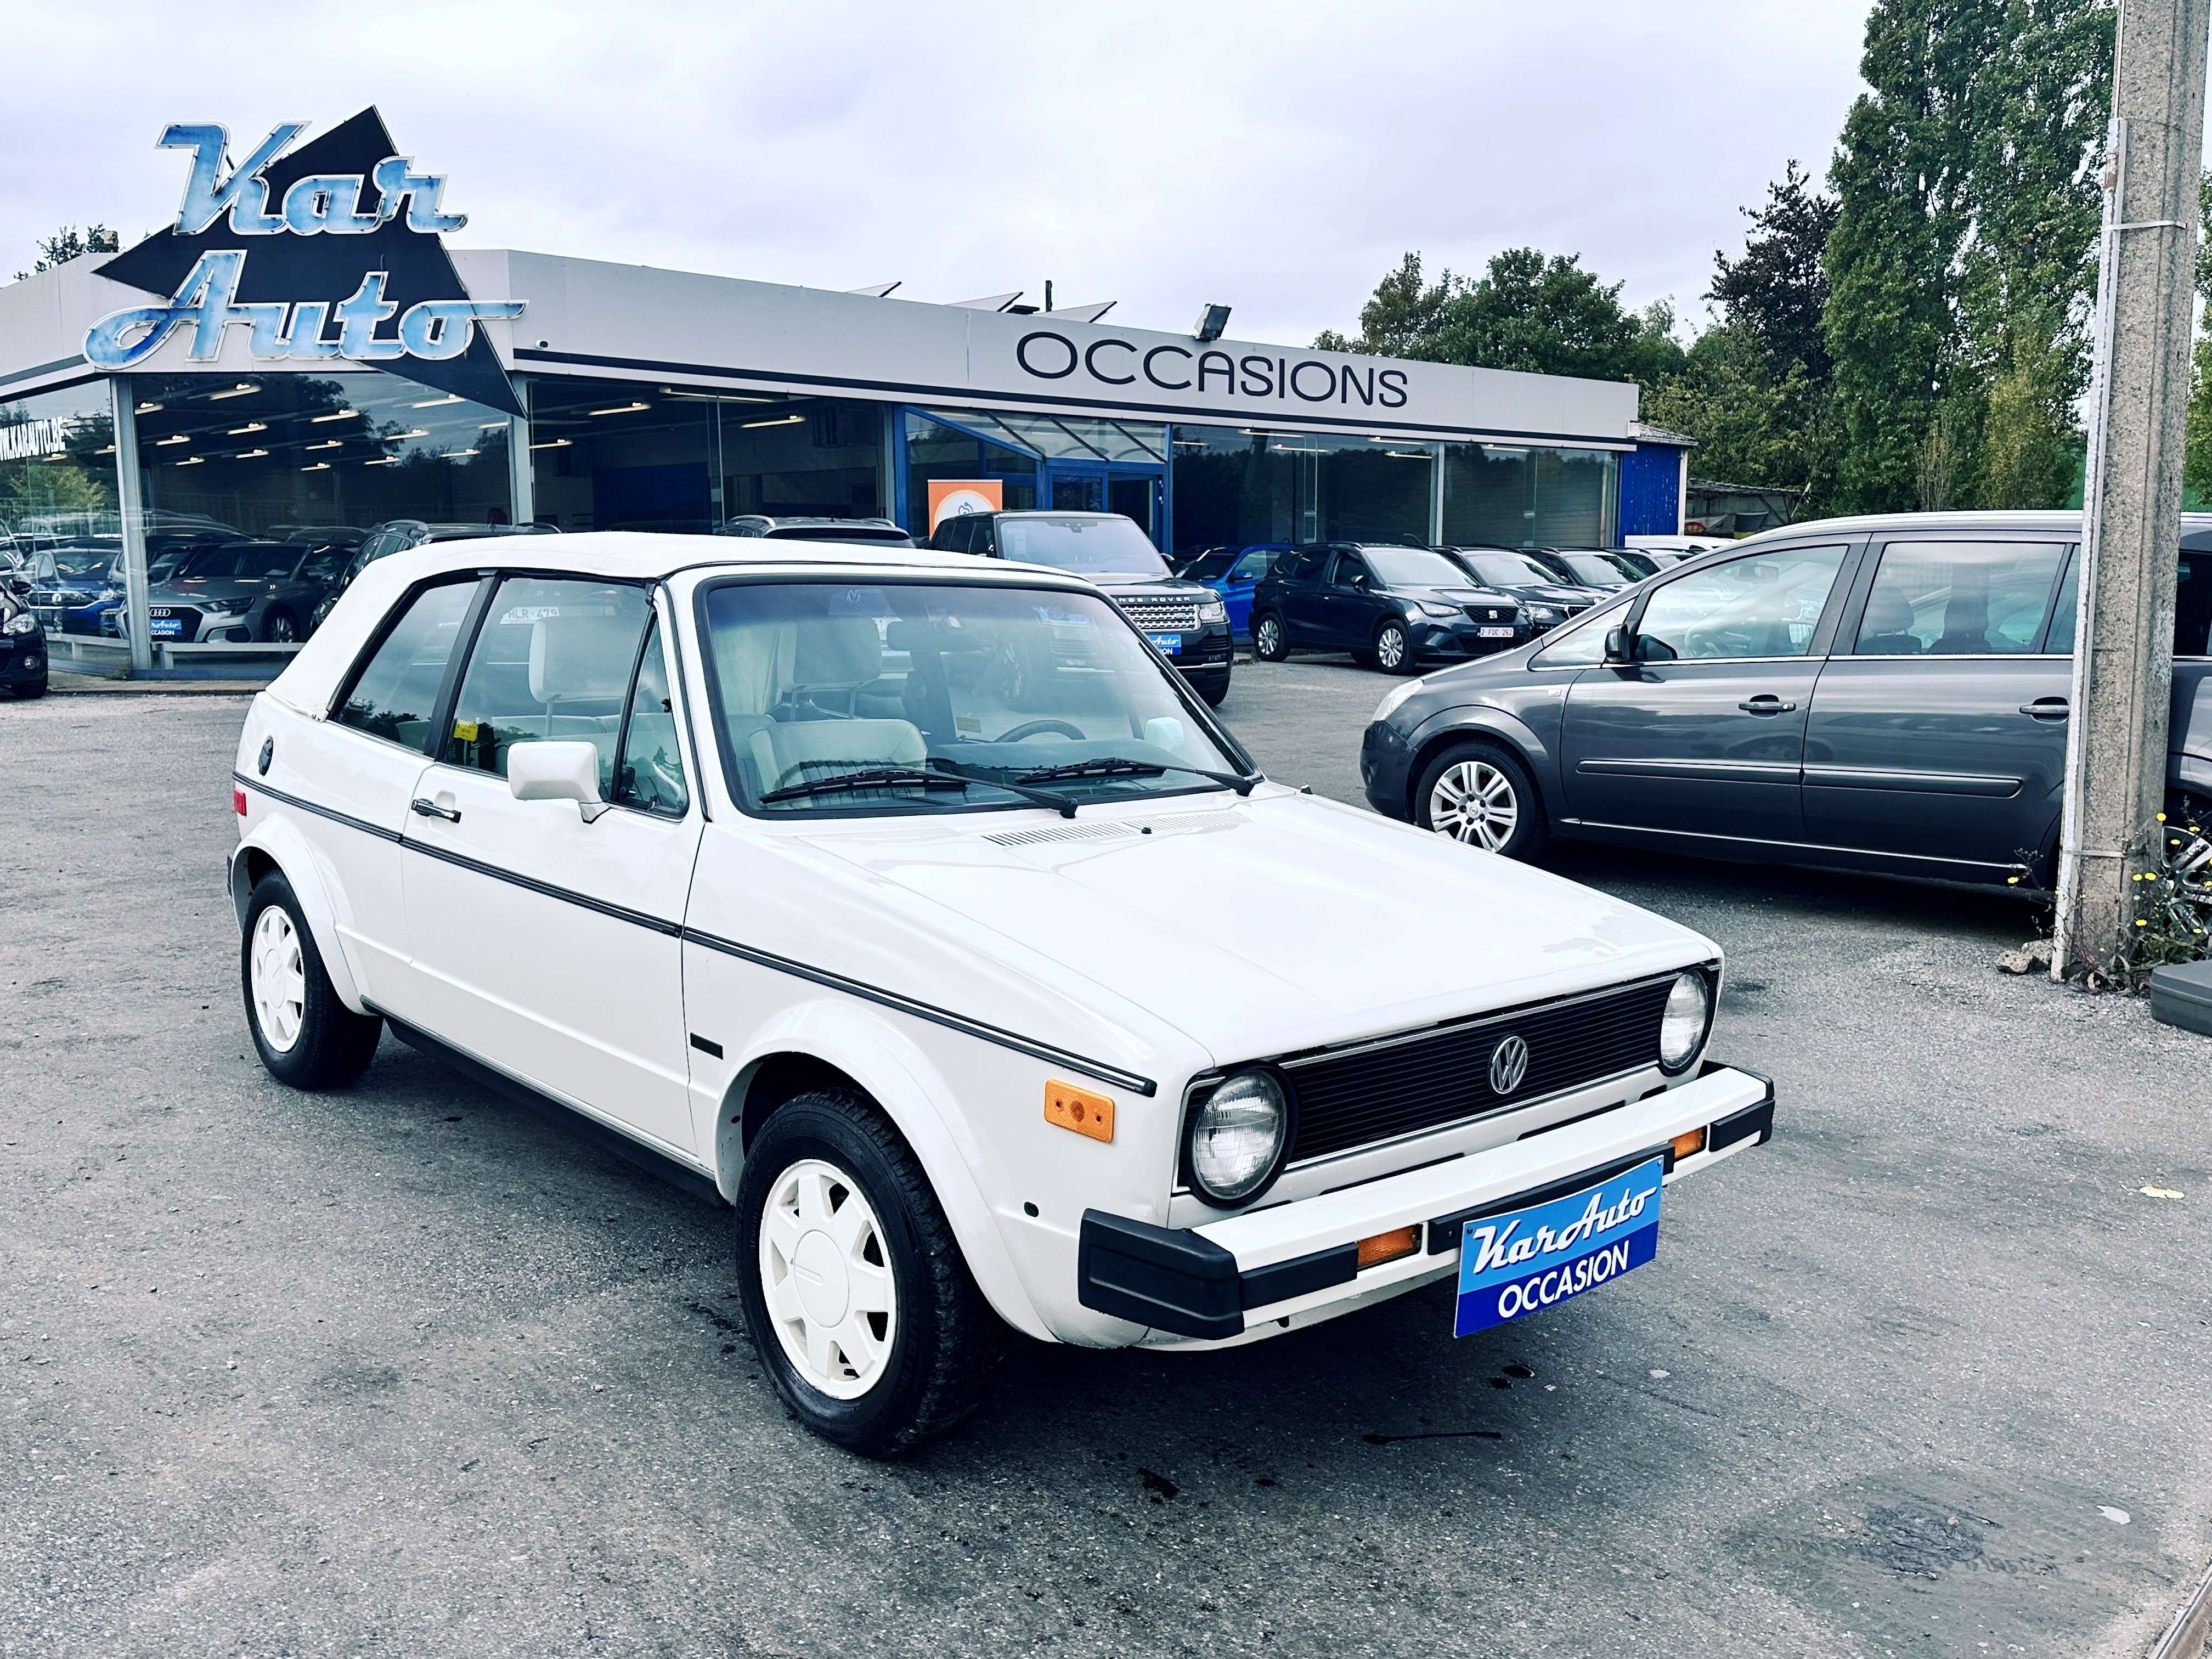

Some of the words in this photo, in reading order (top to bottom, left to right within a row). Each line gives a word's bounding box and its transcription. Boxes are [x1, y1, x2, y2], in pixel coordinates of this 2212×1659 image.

[154, 121, 468, 236] Kar
[81, 249, 529, 370] Auto
[1017, 331, 1408, 408] OCCASIONS
[1498, 1240, 1629, 1318] OCCASION
